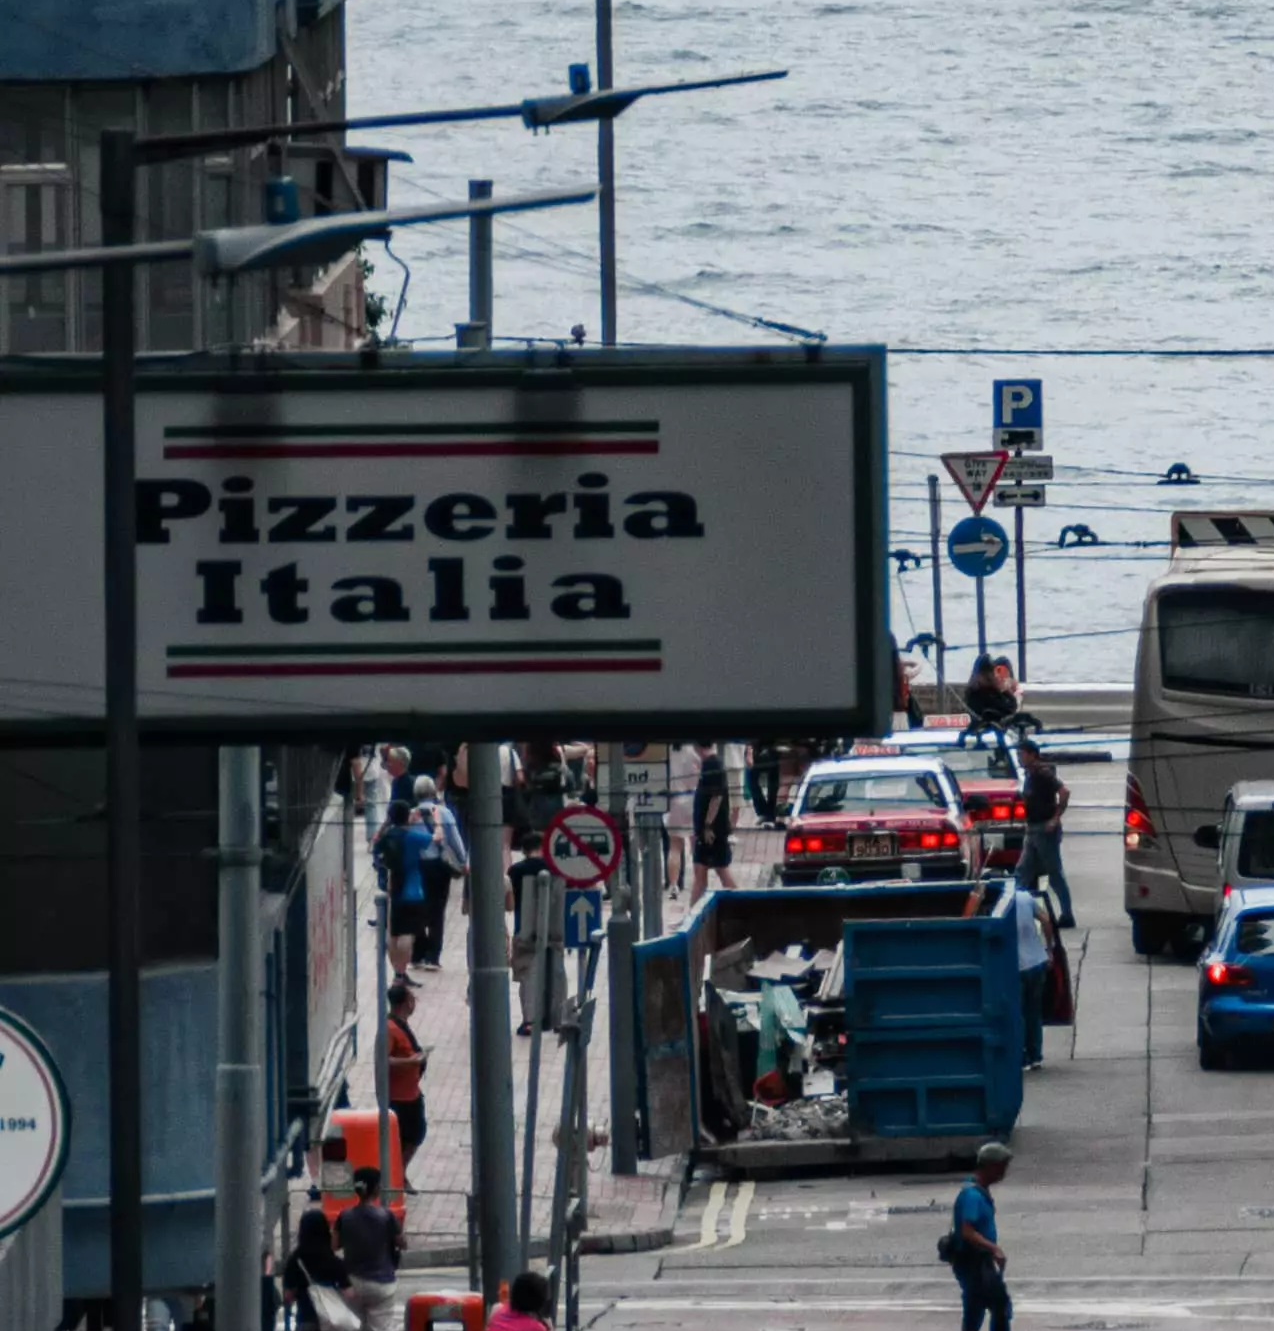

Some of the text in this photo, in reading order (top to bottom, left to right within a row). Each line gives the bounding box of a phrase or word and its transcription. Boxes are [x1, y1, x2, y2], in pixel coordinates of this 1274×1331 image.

[1002, 385, 1033, 424] P
[966, 470, 987, 478] WAY
[135, 472, 705, 545] Pizzeria
[196, 555, 632, 625] Italia
